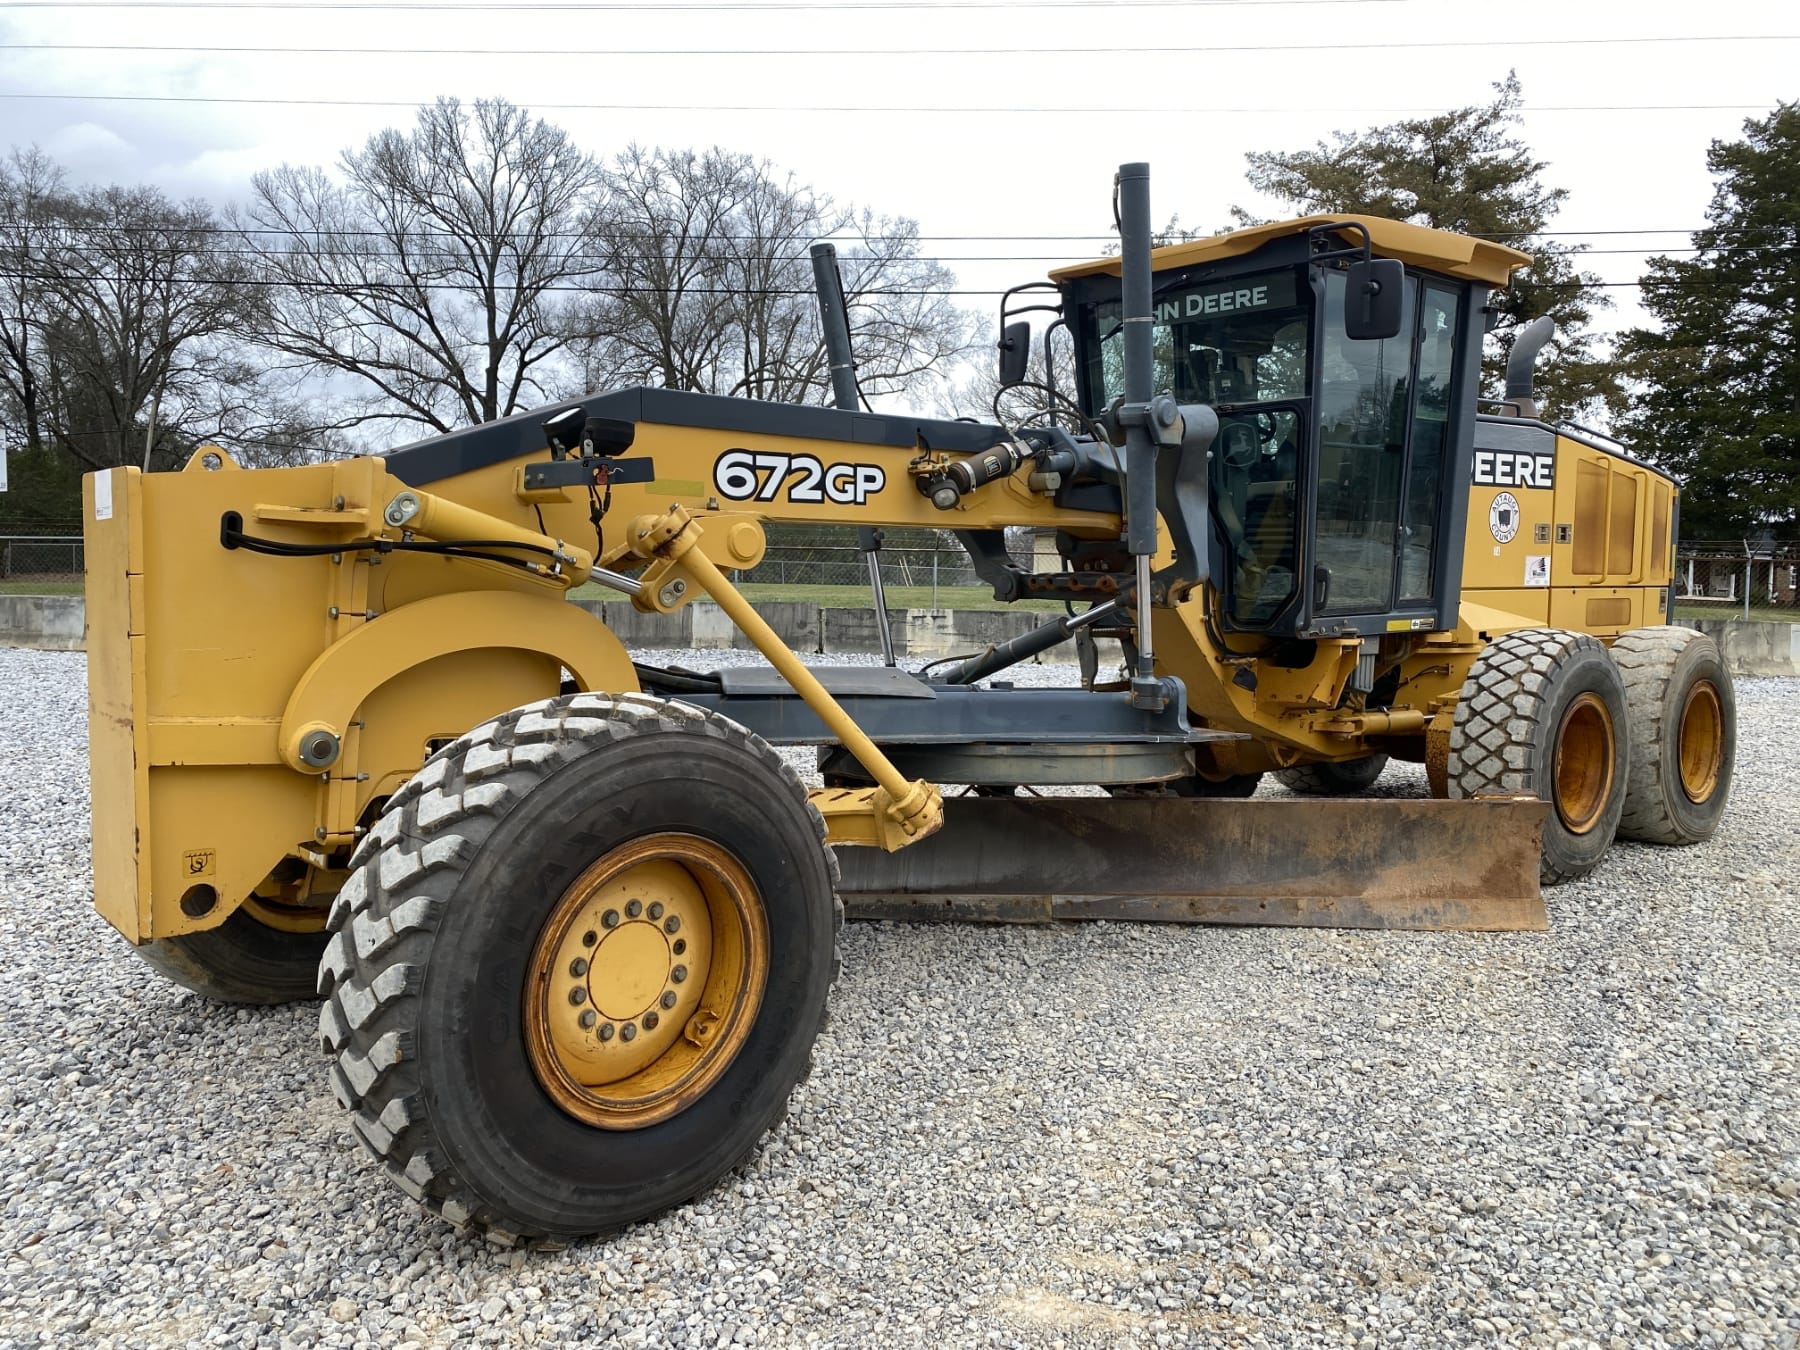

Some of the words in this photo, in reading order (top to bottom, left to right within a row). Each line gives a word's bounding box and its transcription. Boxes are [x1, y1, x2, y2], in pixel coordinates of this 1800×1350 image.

[1152, 301, 1179, 321] HN
[1186, 286, 1267, 317] DEERE
[714, 448, 886, 505] 672GP
[1471, 451, 1553, 487] EERE
